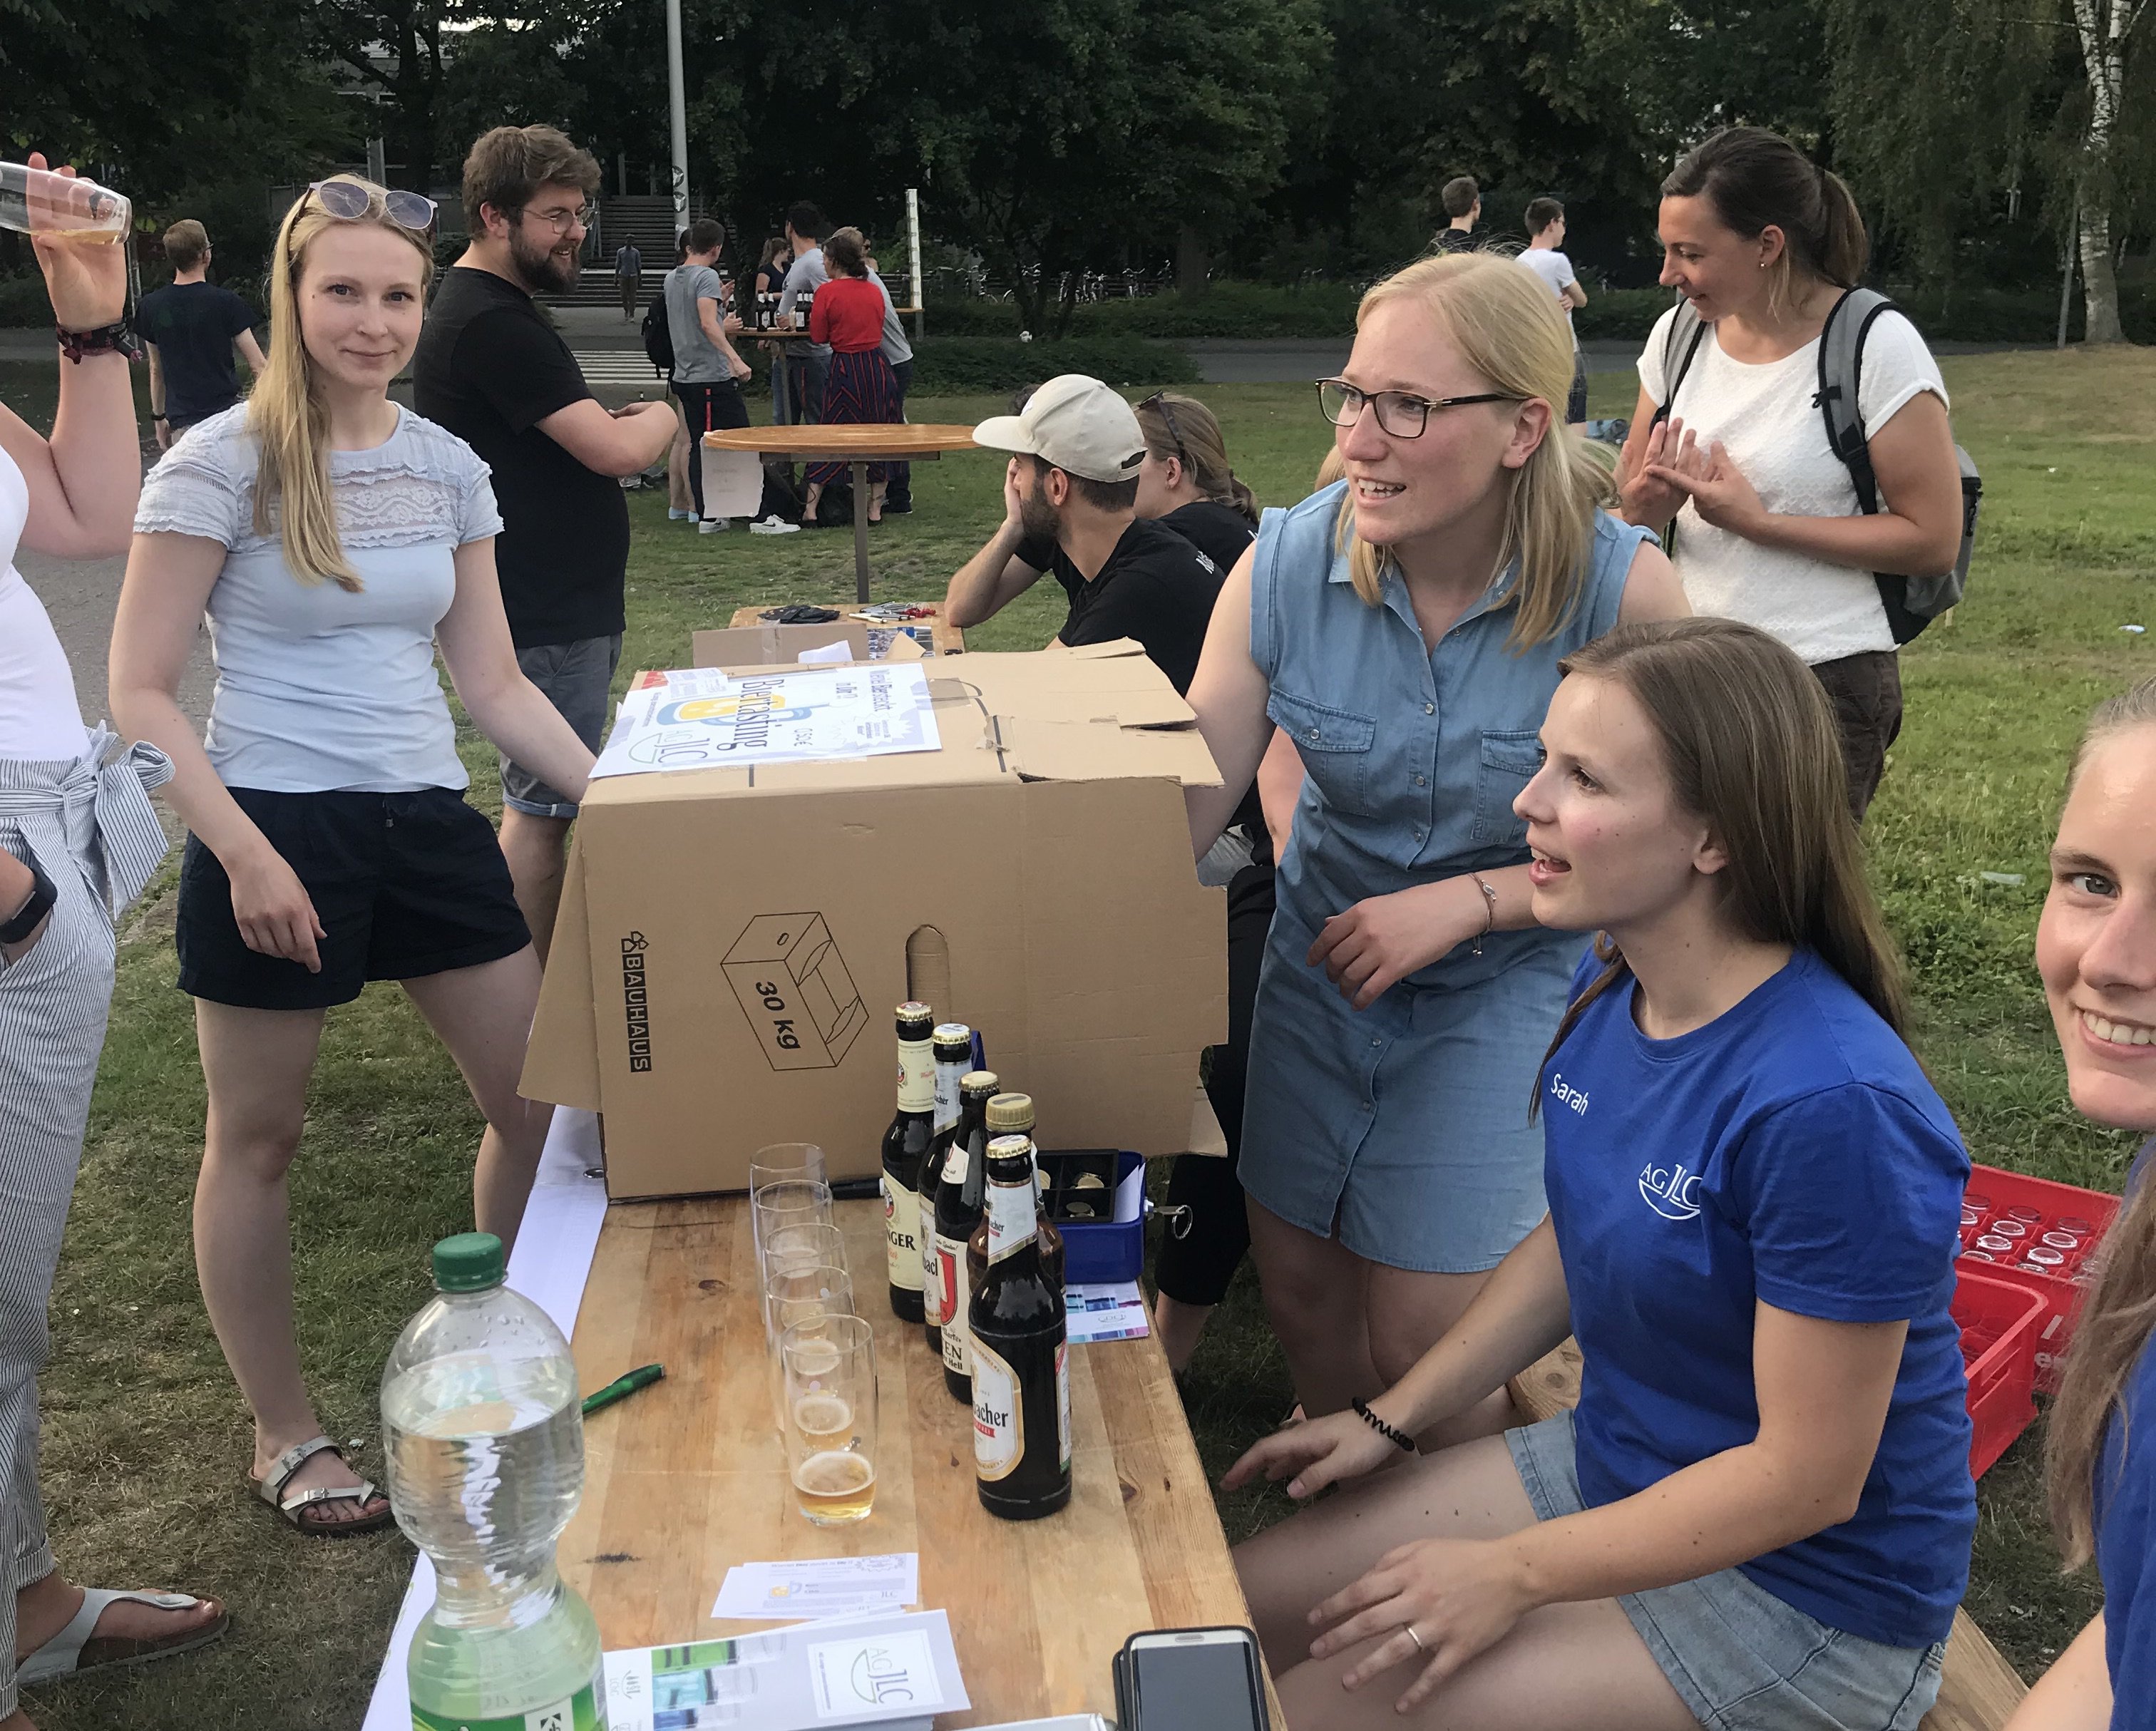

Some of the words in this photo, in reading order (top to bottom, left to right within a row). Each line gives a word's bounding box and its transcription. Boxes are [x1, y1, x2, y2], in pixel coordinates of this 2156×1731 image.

[717, 679, 784, 751] Biertasting
[623, 954, 652, 1072] BAUHAUS
[755, 980, 785, 1012] 30
[774, 1019, 801, 1050] kg
[1551, 1074, 1589, 1116] Sarah
